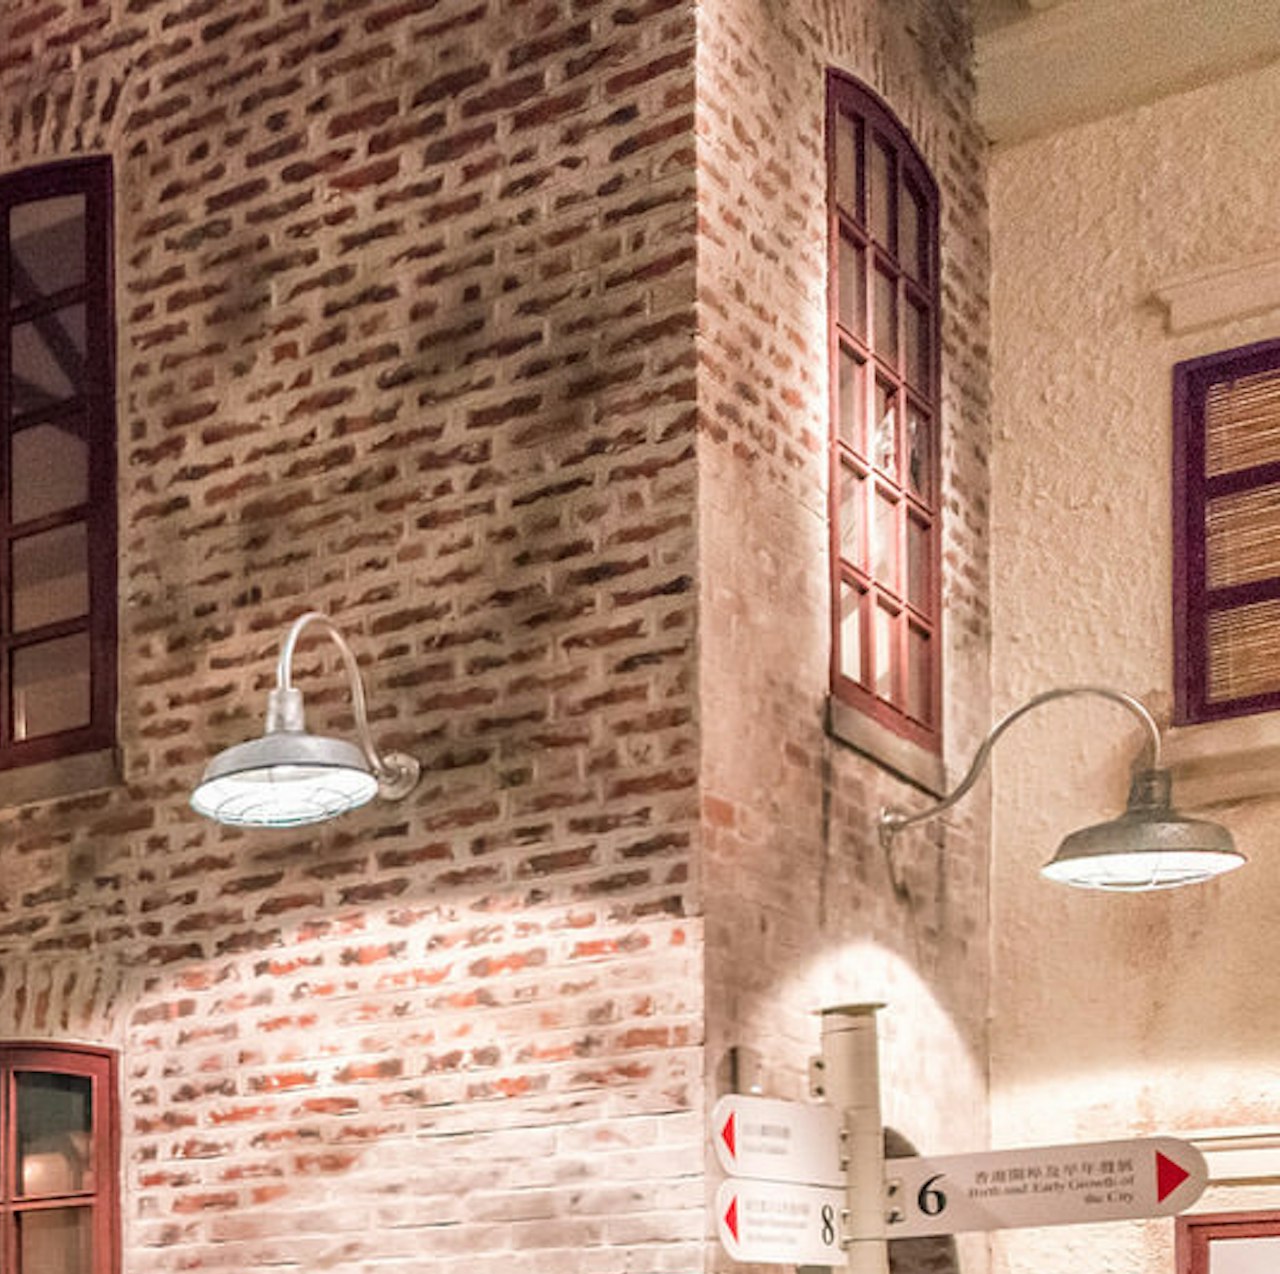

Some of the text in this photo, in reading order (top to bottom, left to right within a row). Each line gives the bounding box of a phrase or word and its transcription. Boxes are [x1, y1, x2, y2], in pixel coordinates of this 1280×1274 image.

[917, 1173, 947, 1217] 6
[1003, 1182, 1029, 1195] and
[1032, 1181, 1065, 1195] Early
[1068, 1176, 1117, 1191] Growth
[1119, 1174, 1135, 1188] of
[1106, 1192, 1134, 1205] City
[821, 1204, 835, 1247] 8
